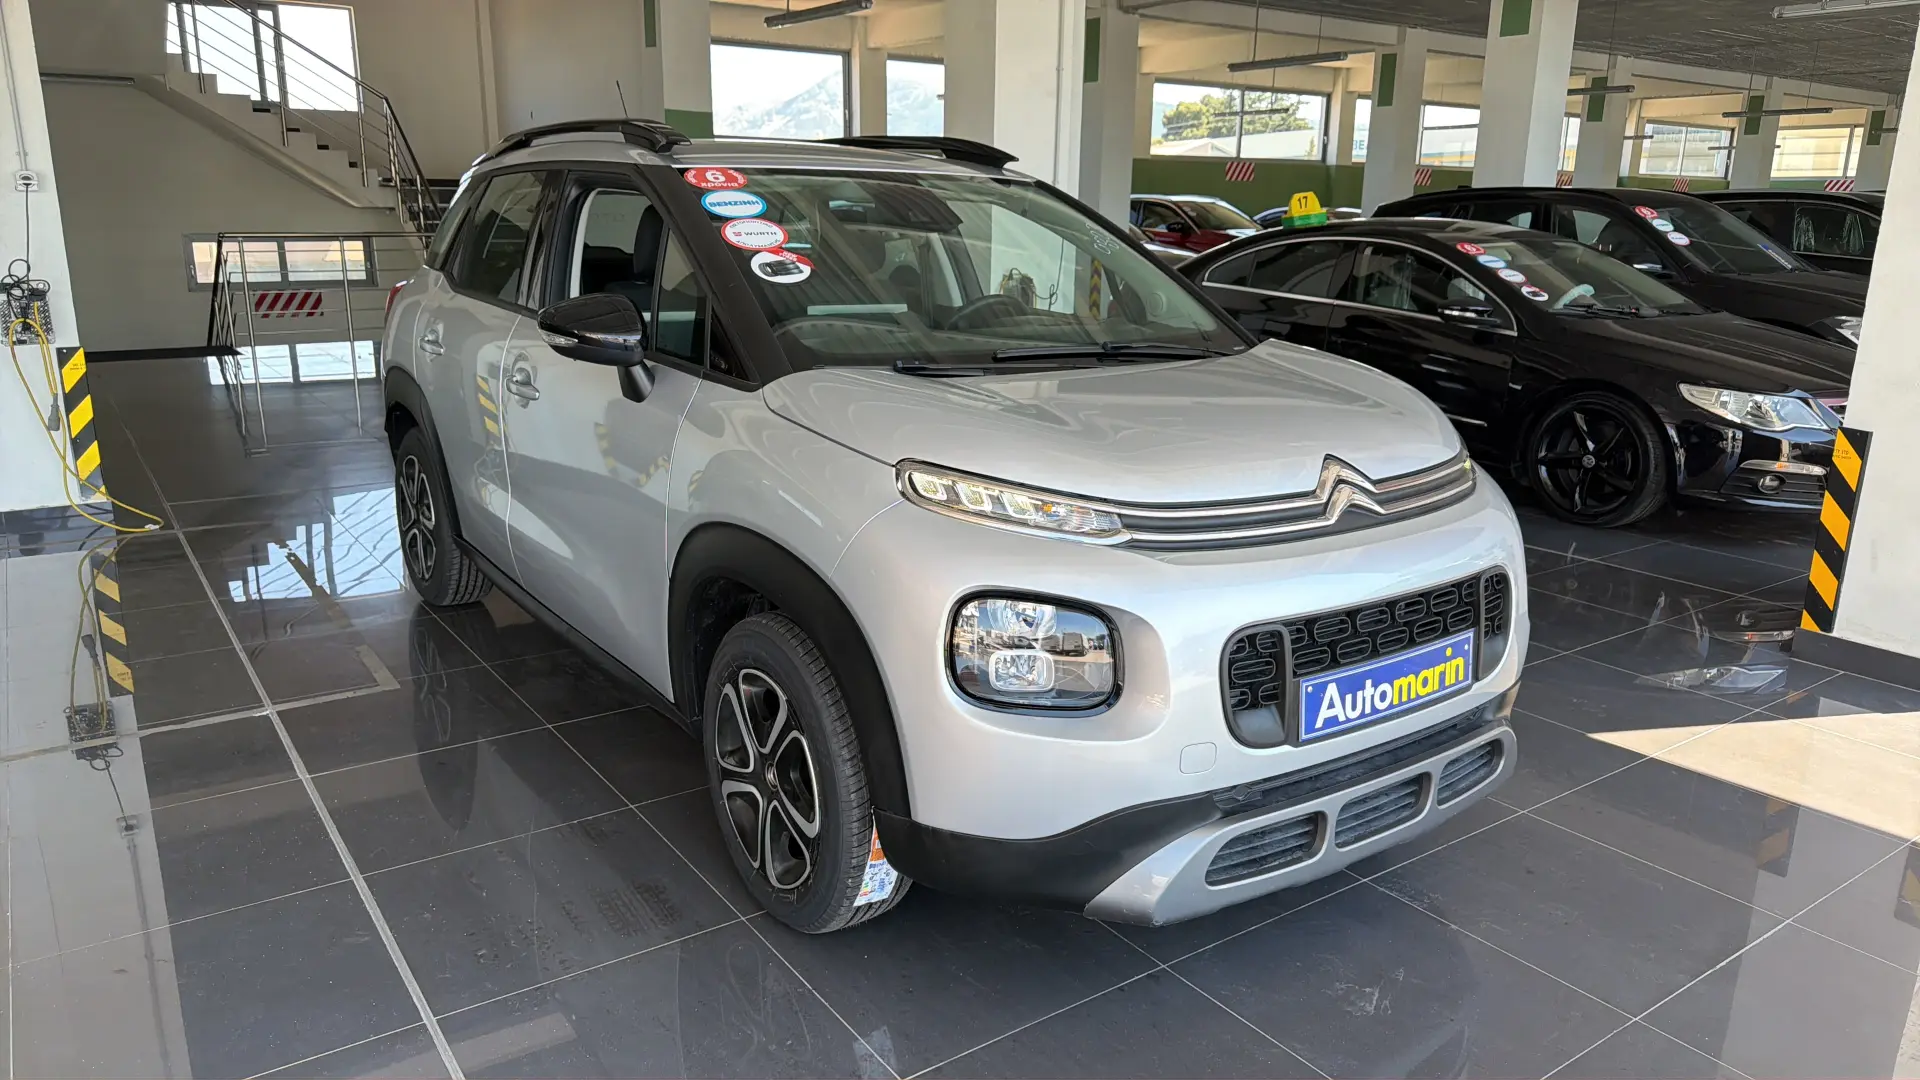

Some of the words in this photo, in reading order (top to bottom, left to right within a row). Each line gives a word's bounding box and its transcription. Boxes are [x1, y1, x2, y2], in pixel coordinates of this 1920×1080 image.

[705, 171, 726, 183] 6
[1297, 195, 1308, 210] 17
[1315, 647, 1464, 729] Automarin
